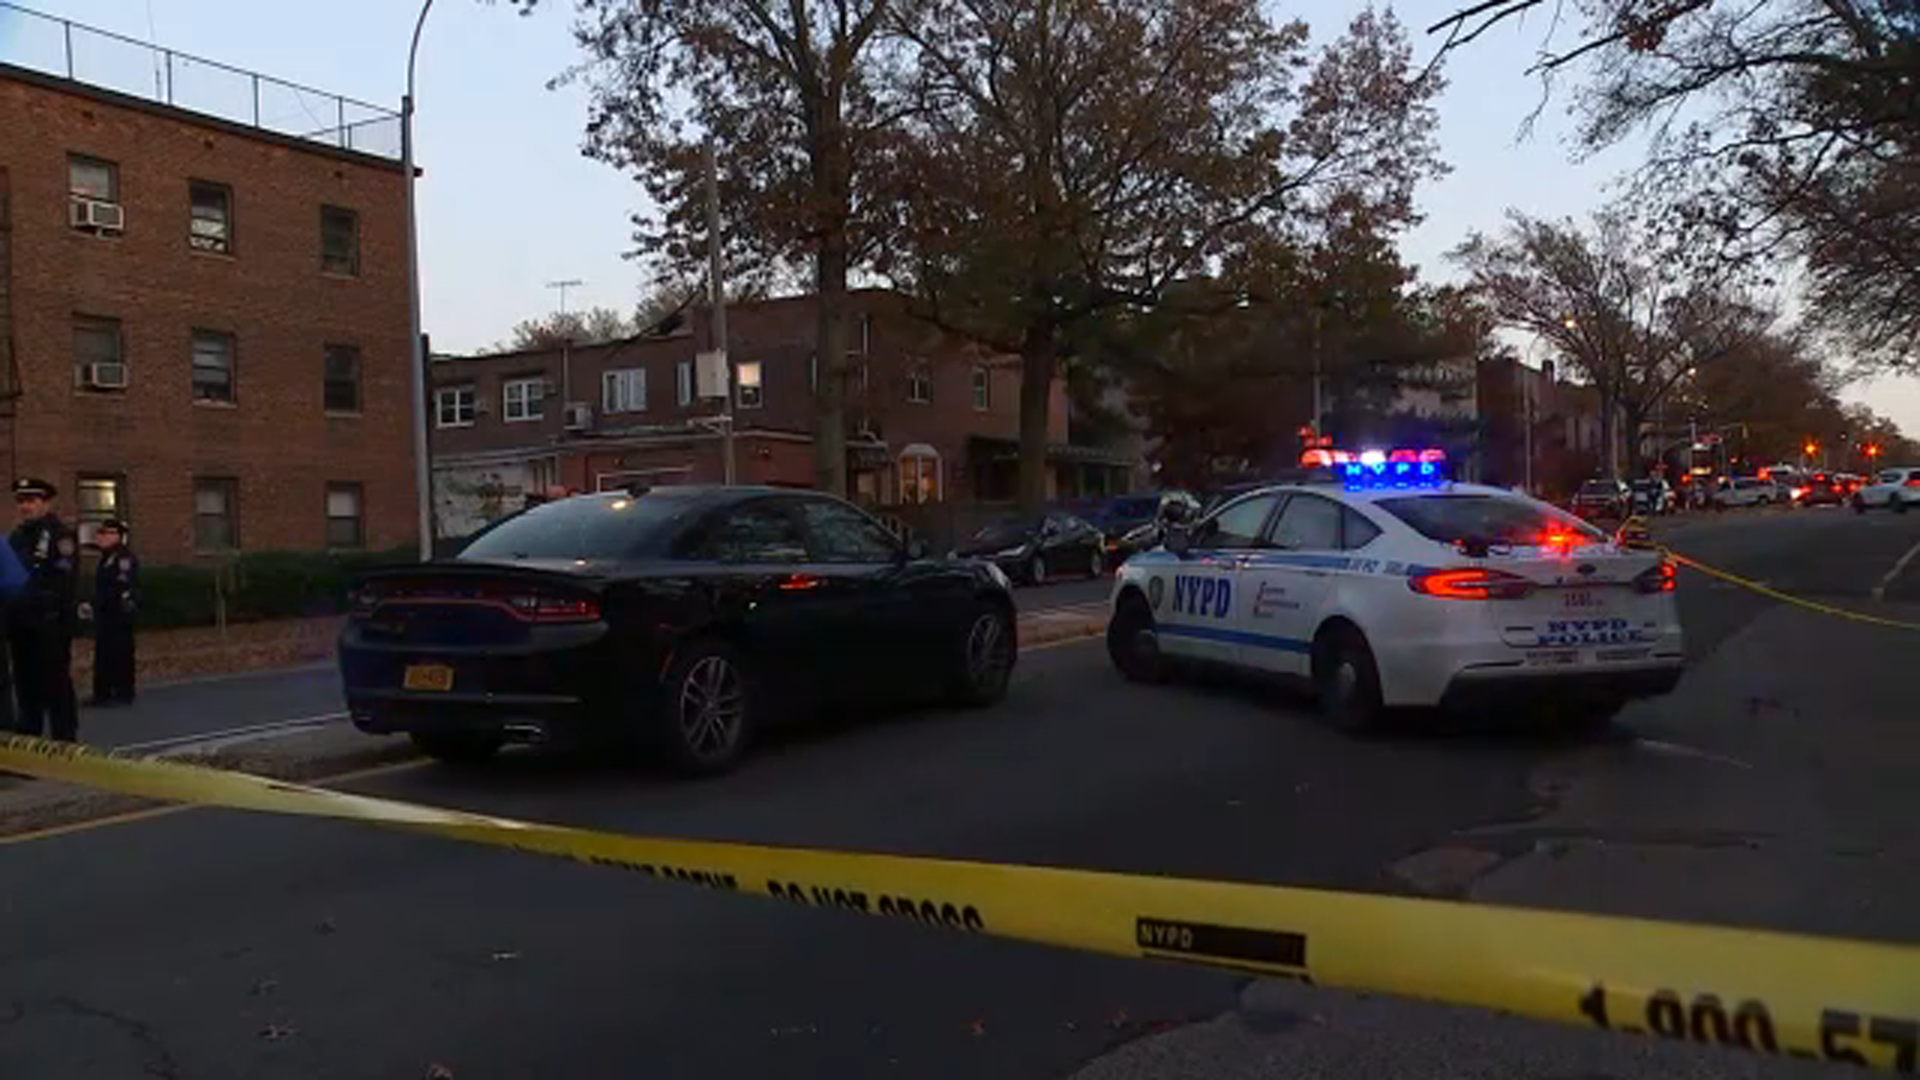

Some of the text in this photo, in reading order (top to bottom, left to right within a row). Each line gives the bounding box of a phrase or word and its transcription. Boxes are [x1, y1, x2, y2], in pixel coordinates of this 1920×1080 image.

[1345, 461, 1436, 476] NYPD
[1172, 574, 1232, 618] NYPD
[1547, 617, 1628, 633] NYPD
[1537, 630, 1643, 645] POLICE
[1139, 921, 1194, 949] NYPD
